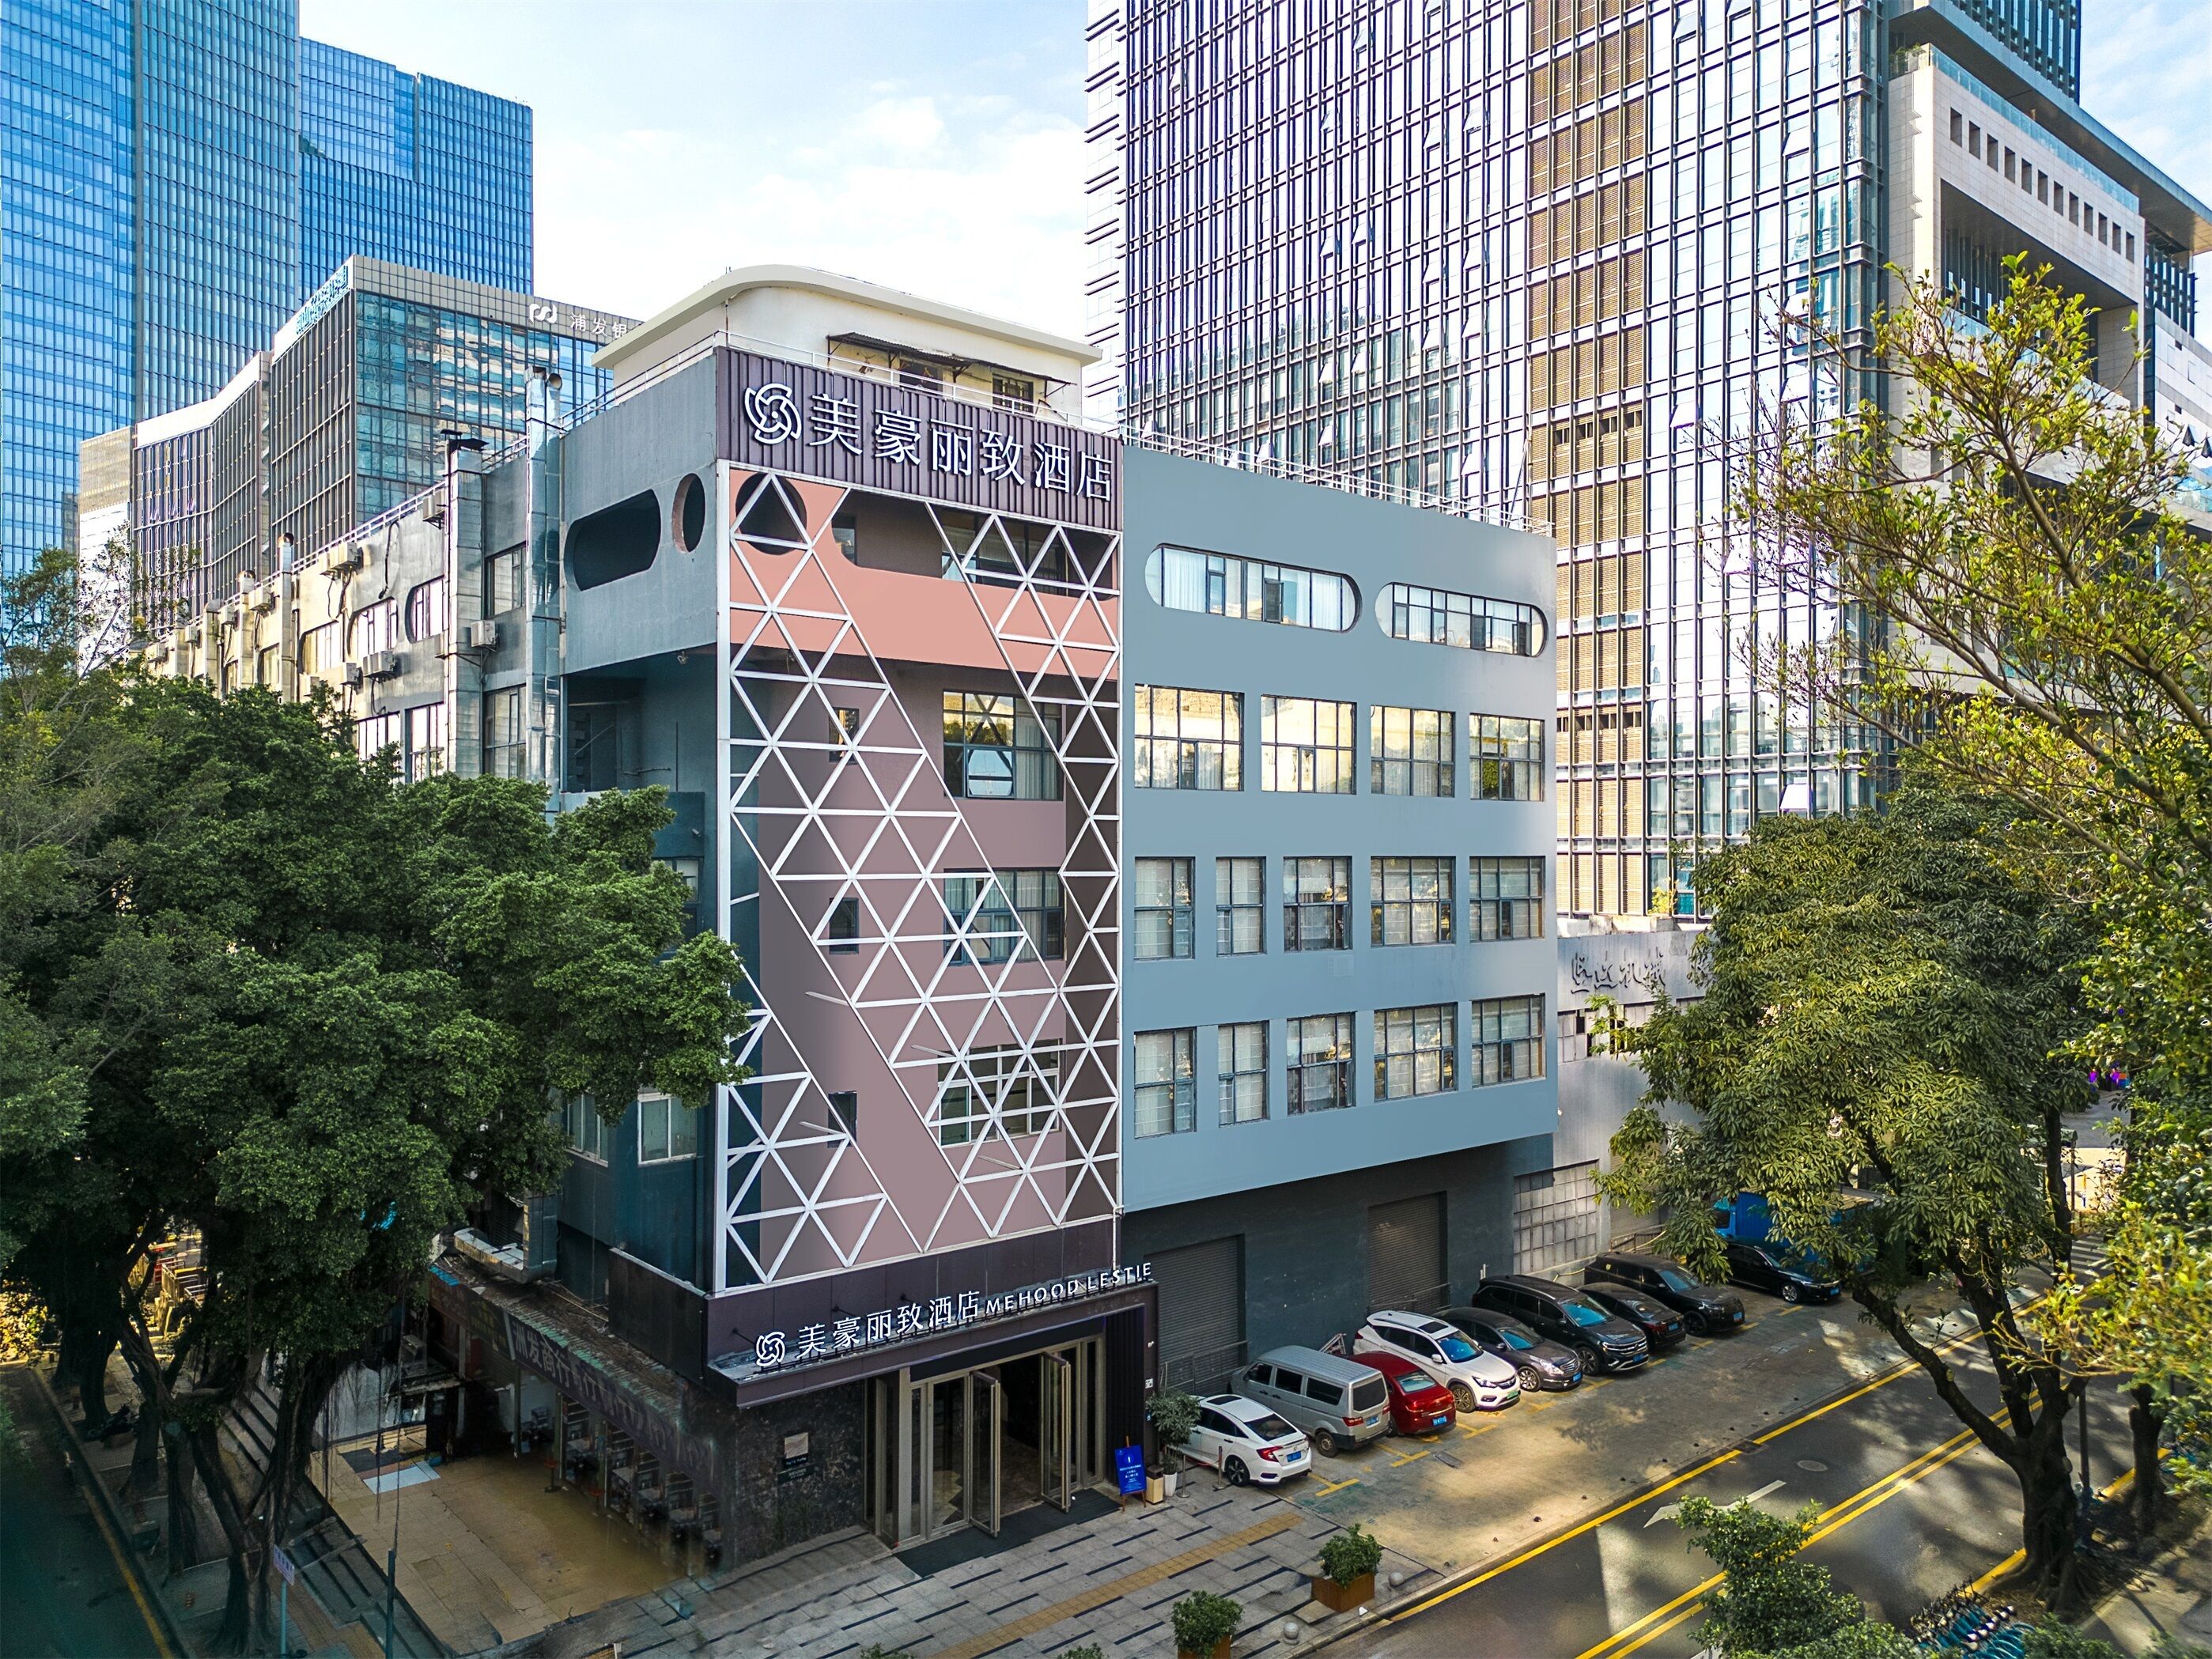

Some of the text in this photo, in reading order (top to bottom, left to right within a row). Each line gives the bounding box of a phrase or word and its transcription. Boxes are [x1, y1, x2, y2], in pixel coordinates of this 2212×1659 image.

[809, 393, 1113, 502] 美豪丽致酒店
[796, 1262, 1151, 1359] 美豪丽致酒店 MEHOOD LESTIE
